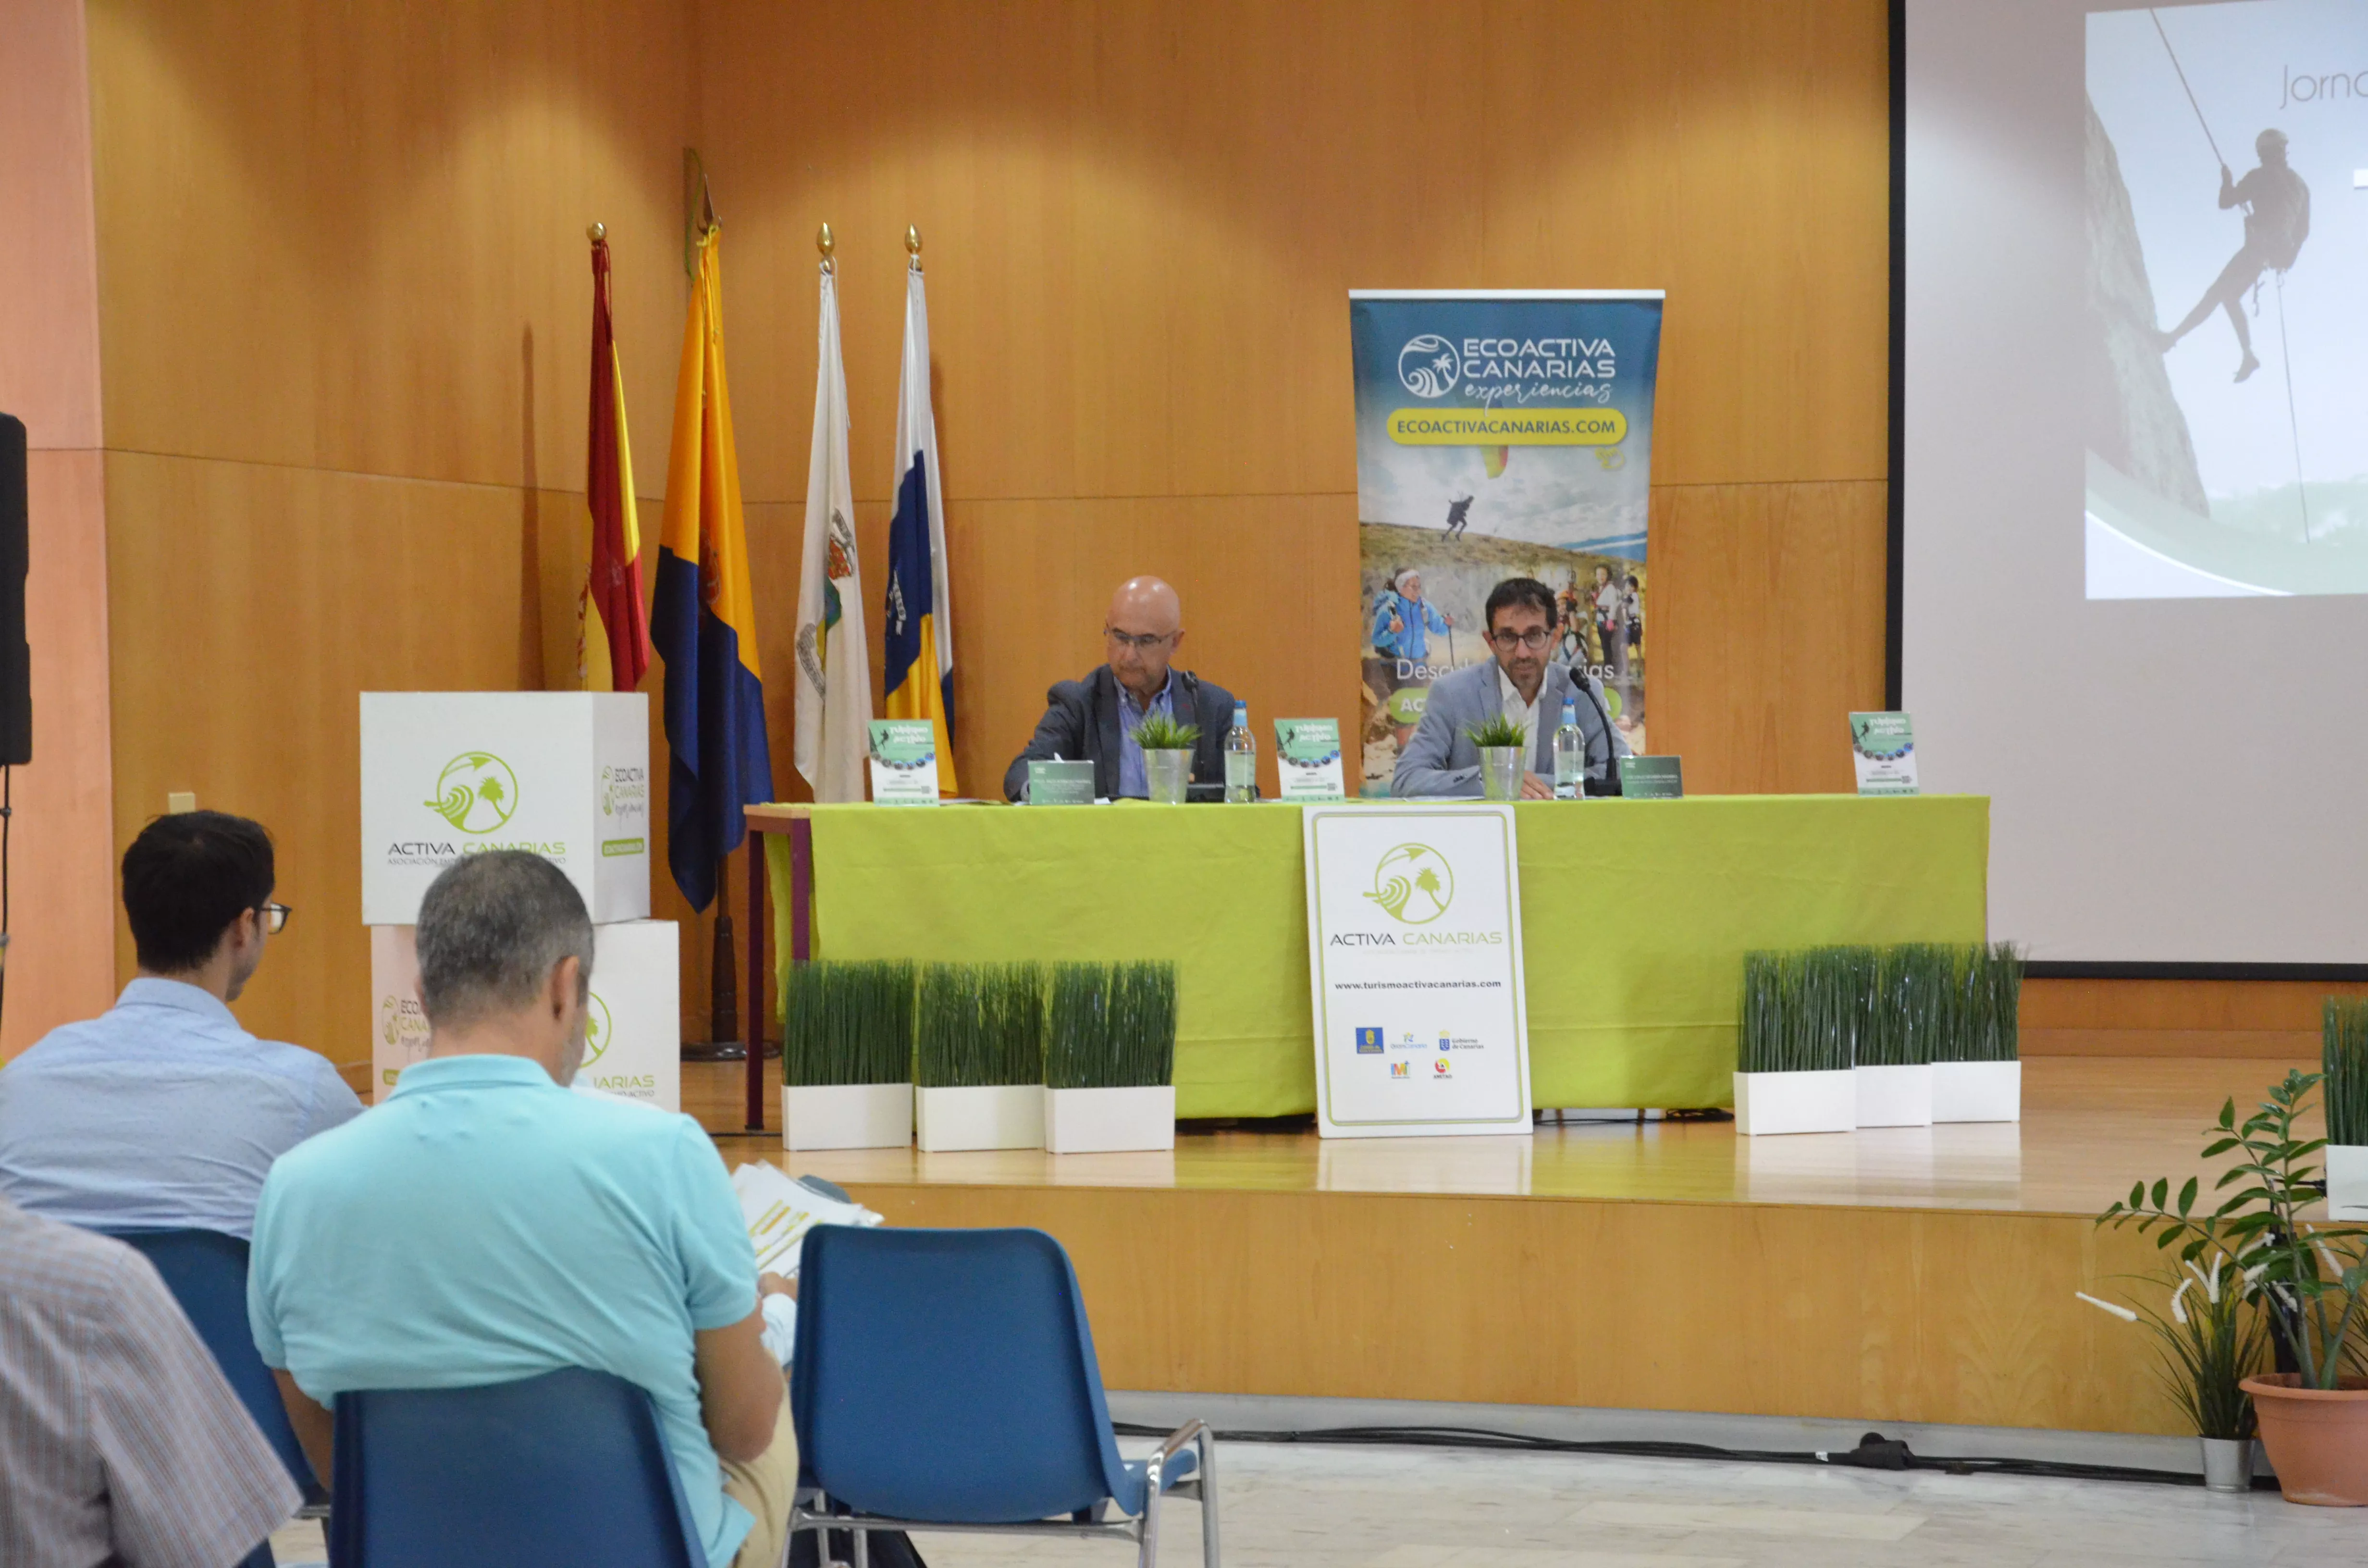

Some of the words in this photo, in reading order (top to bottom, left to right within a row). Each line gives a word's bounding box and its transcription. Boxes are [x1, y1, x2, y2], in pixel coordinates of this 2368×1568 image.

[1463, 339, 1616, 357] ECOACTIVA
[1463, 360, 1616, 378] CANARIAS
[1465, 381, 1612, 416] experiencias
[1398, 420, 1615, 434] ECOACTIVACANARIAS.COM
[388, 842, 456, 855] ACTIVA
[1330, 933, 1395, 946] ACTIVA
[1403, 932, 1502, 945] CANARIAS
[1335, 980, 1501, 990] www.turismoactivacanarias.com
